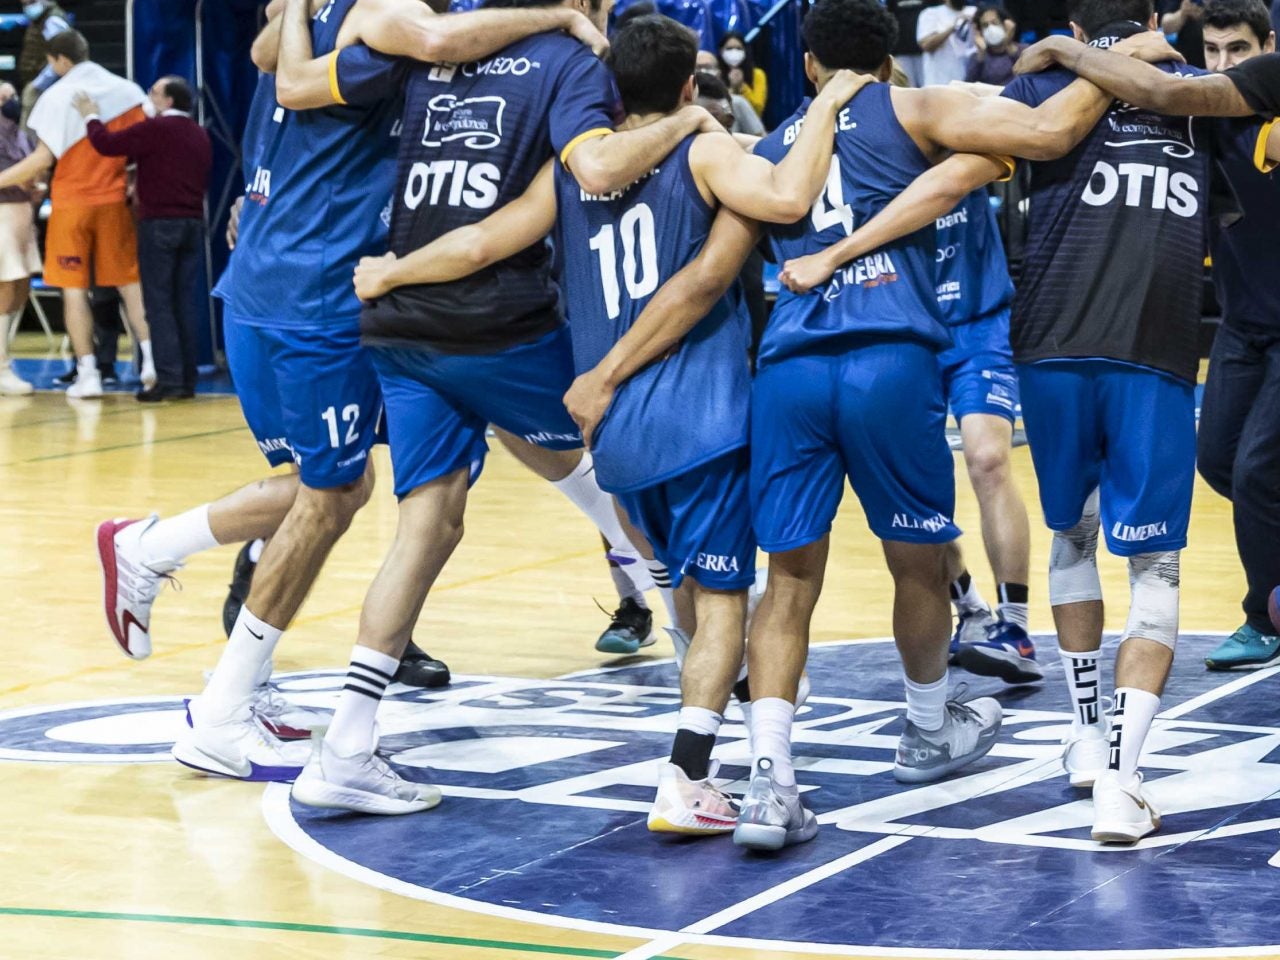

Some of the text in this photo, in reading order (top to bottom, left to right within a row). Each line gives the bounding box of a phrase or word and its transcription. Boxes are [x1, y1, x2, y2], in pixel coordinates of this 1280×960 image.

[404, 159, 501, 210] OTIS
[811, 153, 854, 237] 4
[1081, 160, 1199, 217] OTIS
[589, 202, 659, 320] 10
[322, 403, 361, 449] 12
